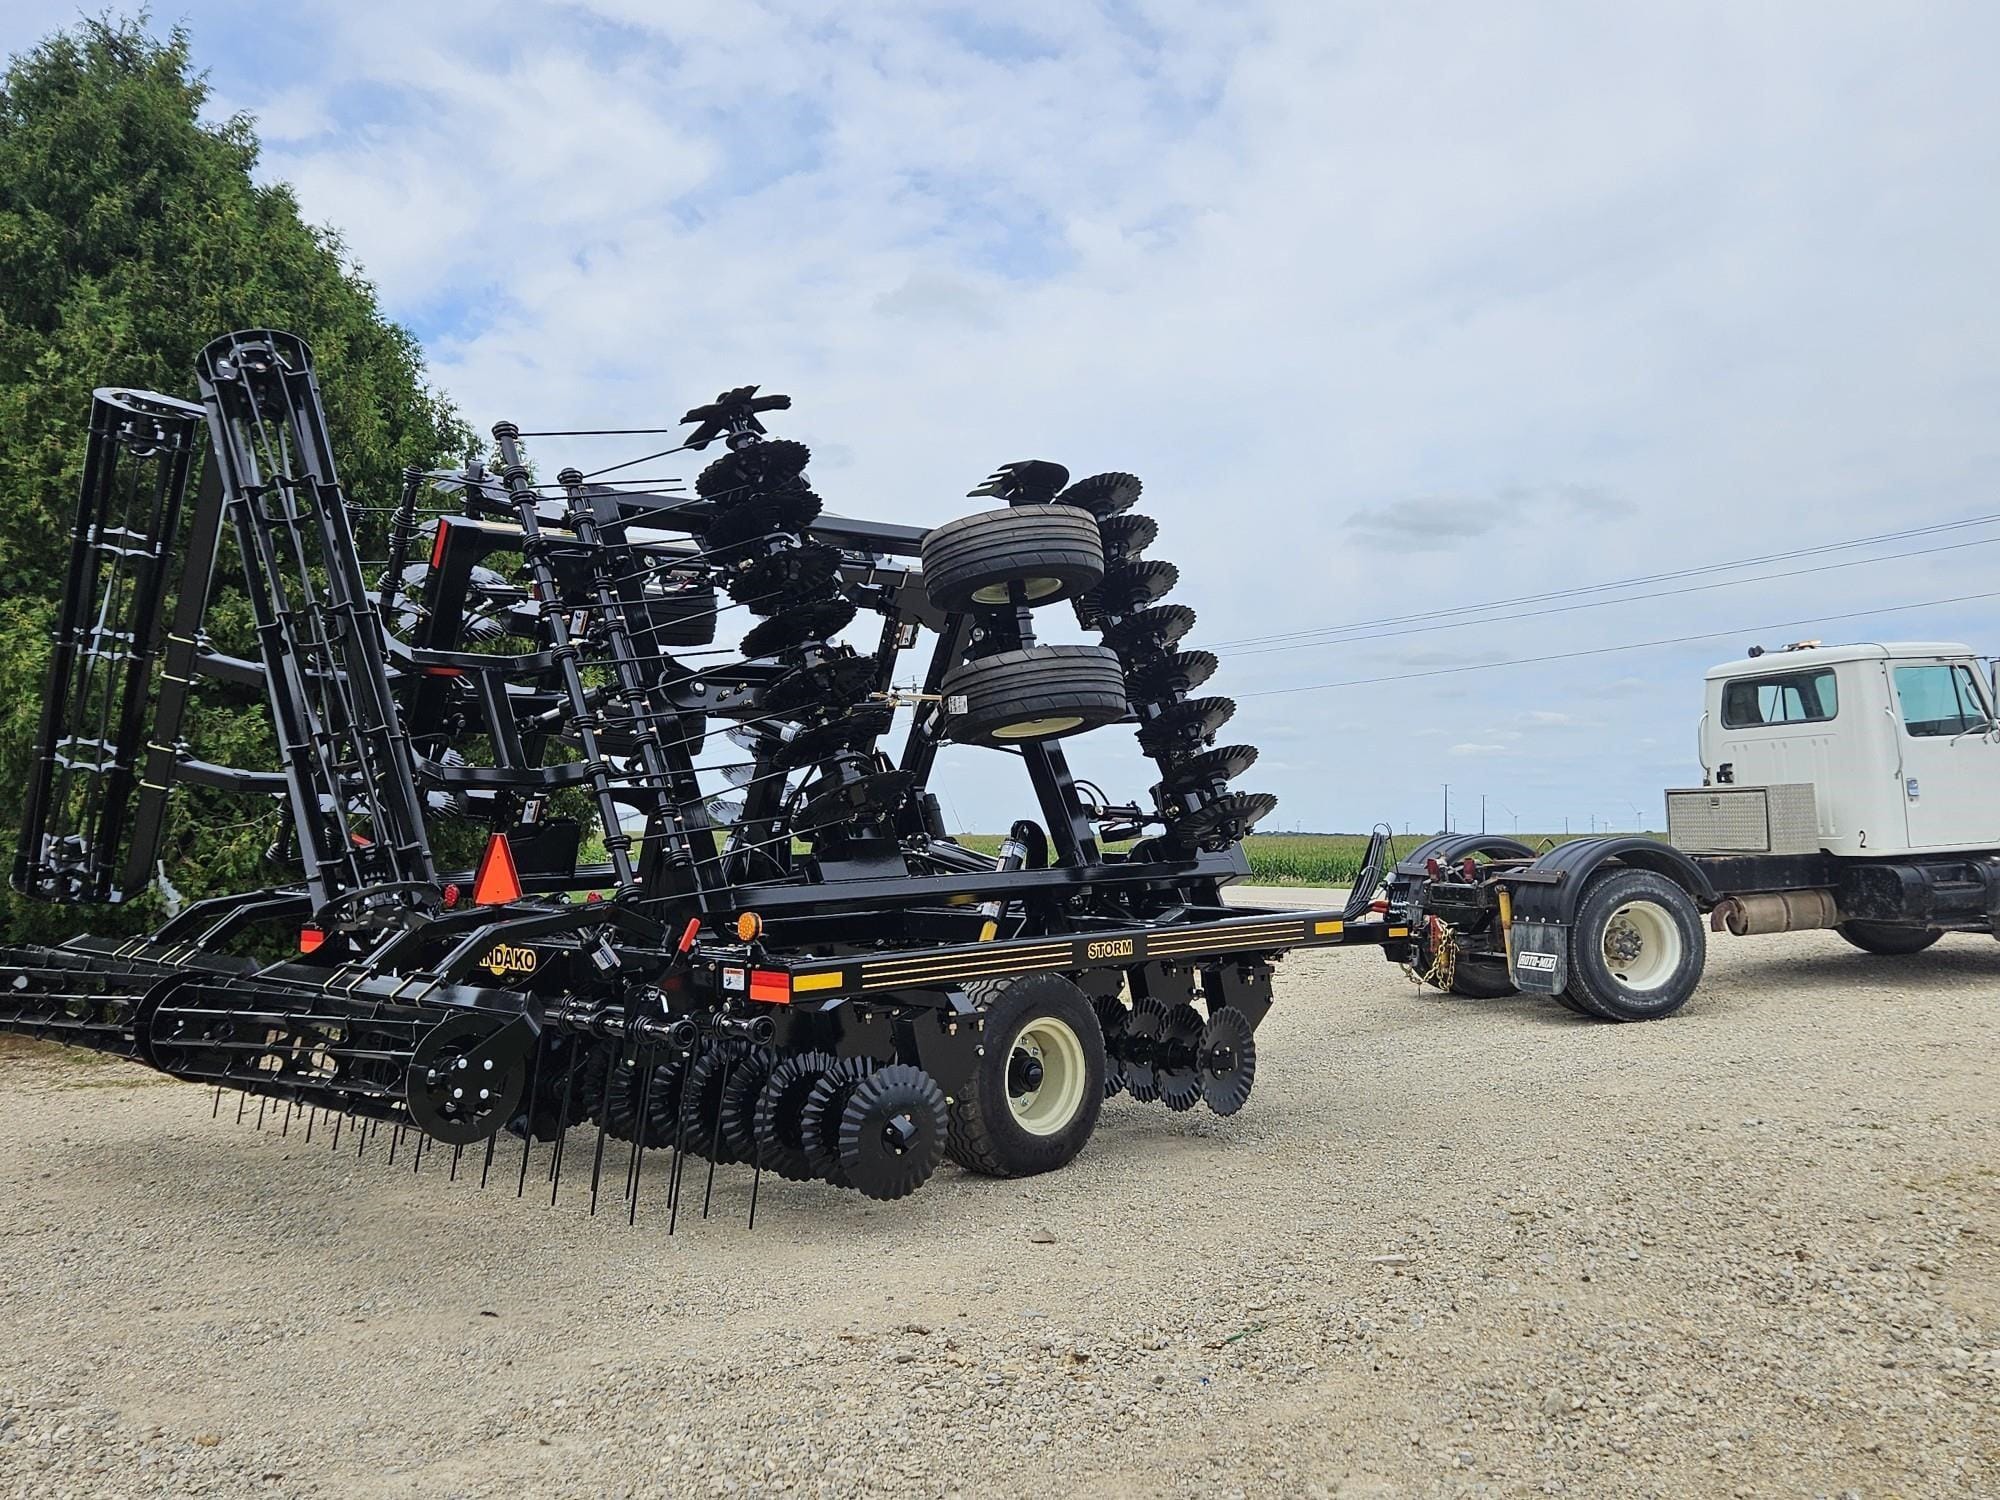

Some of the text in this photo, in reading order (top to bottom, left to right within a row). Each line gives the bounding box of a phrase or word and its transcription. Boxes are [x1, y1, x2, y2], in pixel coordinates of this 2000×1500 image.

[1858, 830, 1867, 848] 2
[479, 946, 537, 972] NDAKO
[1087, 939, 1133, 959] STORM
